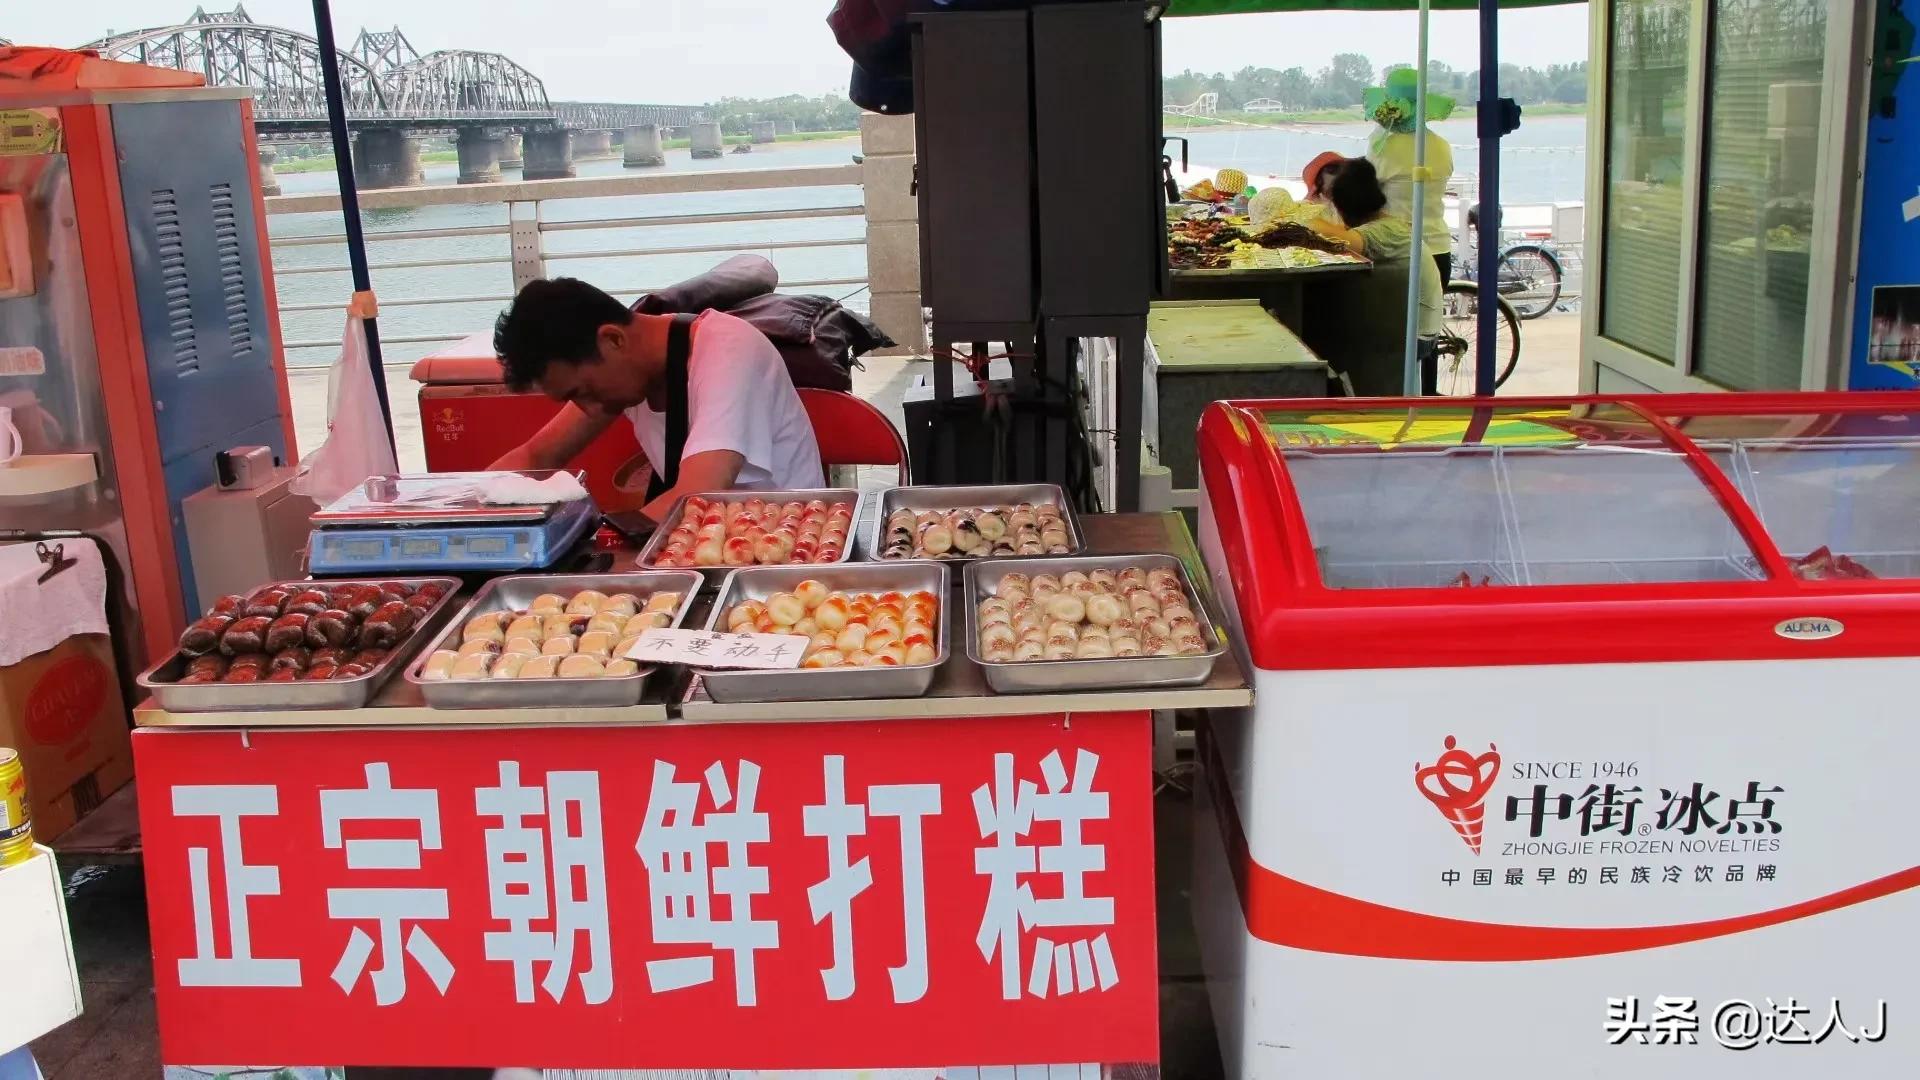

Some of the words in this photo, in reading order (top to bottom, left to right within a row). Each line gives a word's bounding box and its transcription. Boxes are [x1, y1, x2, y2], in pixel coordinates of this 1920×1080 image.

[1784, 622, 1831, 633] AUCMA
[1512, 761, 1583, 780] SINCE
[1591, 760, 1640, 779] 1946
[1501, 842, 1594, 857] ZHONGJIE
[1599, 840, 1672, 855] FROZEN
[1679, 838, 1781, 853] NOVELTIES
[172, 748, 1119, 1007] 正宗朝鲜打糕
[1441, 863, 1777, 887] 中国最早的民族冷饮品牌
